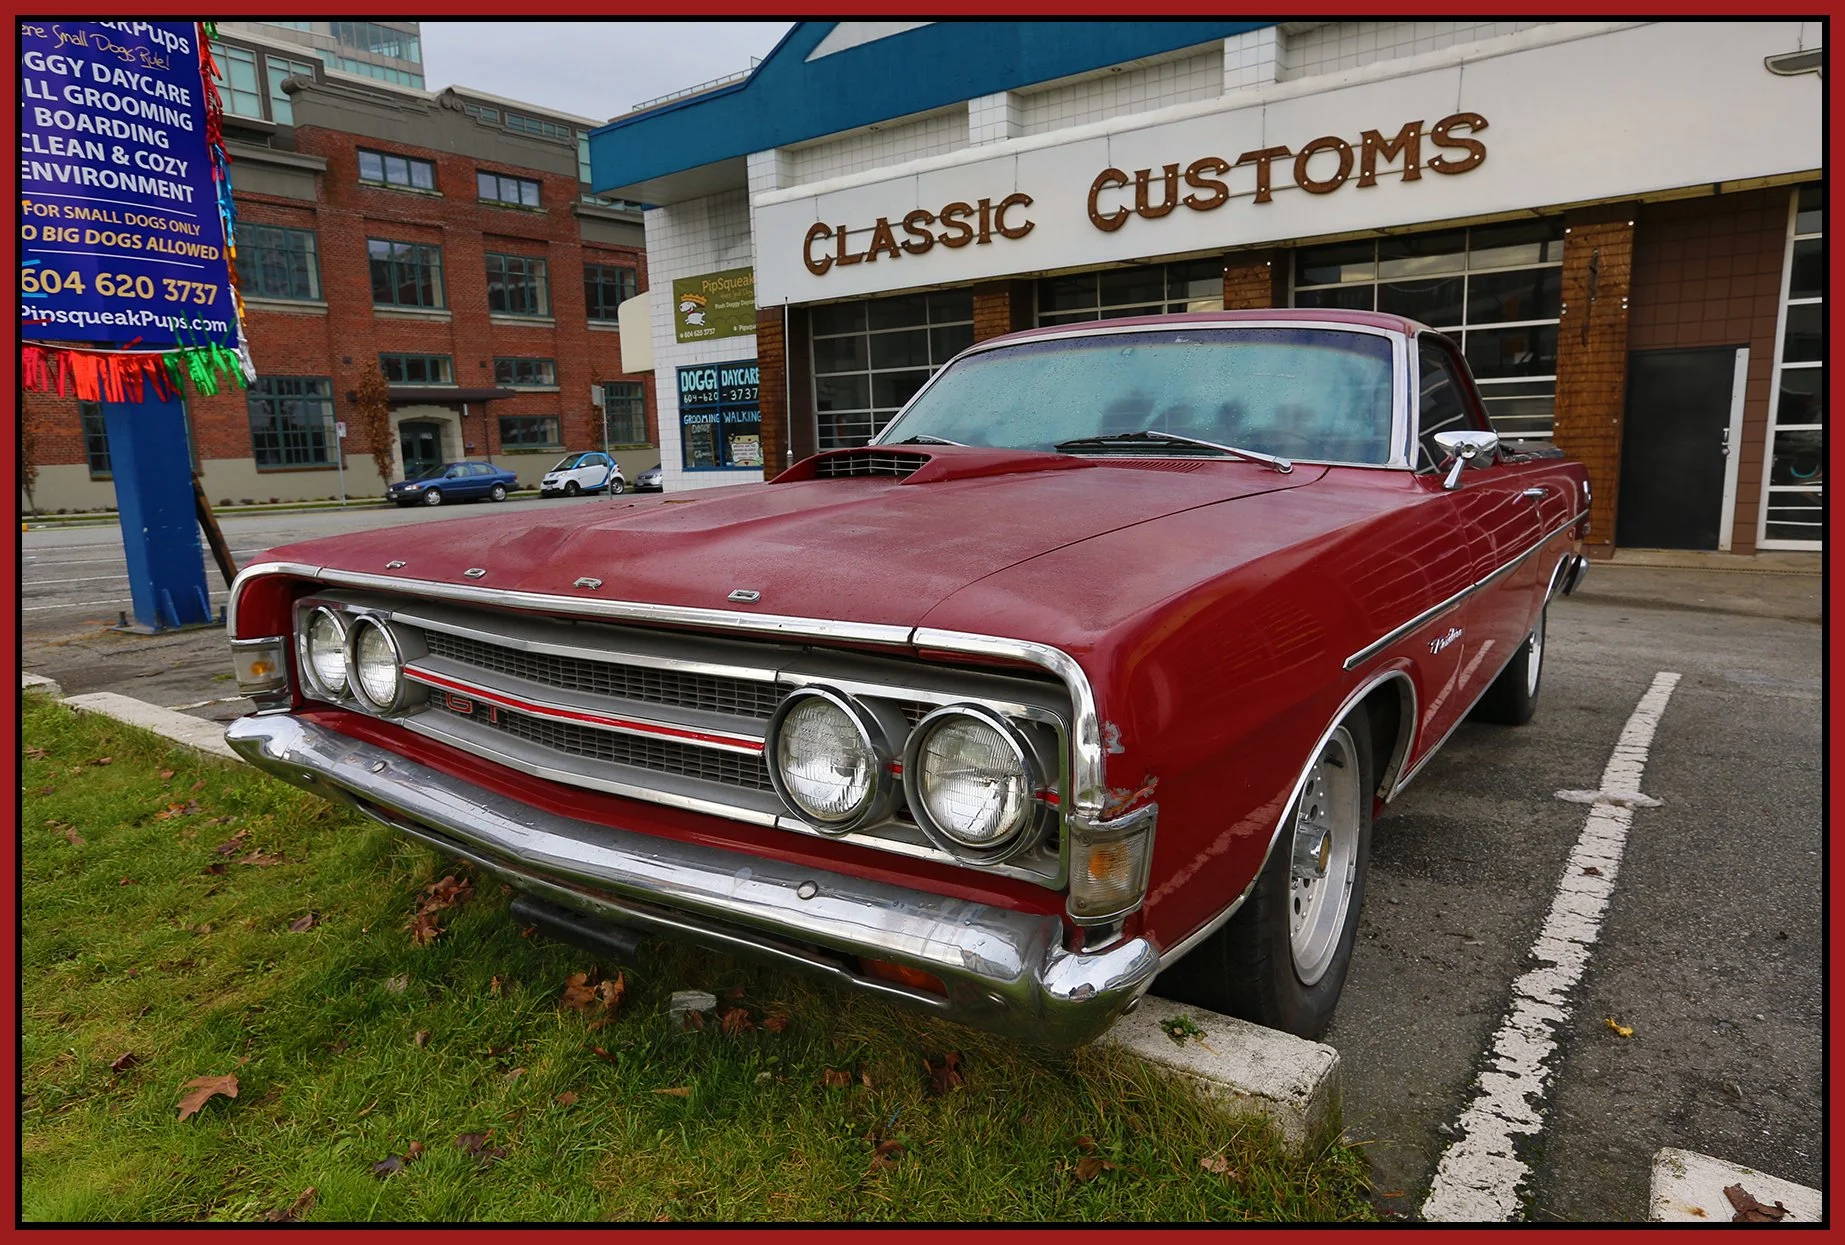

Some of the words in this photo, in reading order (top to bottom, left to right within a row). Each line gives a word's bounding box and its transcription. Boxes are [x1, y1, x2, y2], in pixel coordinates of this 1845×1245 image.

[52, 25, 88, 48] Small
[90, 34, 135, 62] Dogs
[135, 46, 169, 70] Rule!
[22, 51, 85, 78] GGY
[91, 62, 192, 107] DAYCARE
[22, 77, 58, 101] LL
[63, 85, 193, 132] GROOMING
[34, 107, 170, 149] BOARDING
[111, 145, 131, 166] &
[134, 150, 188, 178] COZY
[22, 160, 194, 203] ENVIRONMENT
[803, 192, 1034, 276] CLASSIC
[1086, 112, 1489, 232] CUSTOMS
[22, 203, 60, 218] FOR
[63, 205, 122, 224] SMALL
[124, 213, 167, 231] DOGS
[169, 220, 201, 237] ONLY
[42, 226, 79, 244] BIG
[85, 229, 143, 250] DOGS
[146, 236, 220, 260] ALLOWED
[22, 268, 86, 295] 604
[95, 272, 155, 299] 620
[162, 278, 218, 305] 3737
[22, 305, 228, 333] PipsqueakPups.com
[680, 369, 718, 392] DOGGY
[721, 367, 760, 387] DAYCARE
[683, 391, 720, 404] 604-620
[683, 413, 720, 425] GROOMING
[722, 410, 762, 424] WALKING
[446, 692, 508, 723] GT
